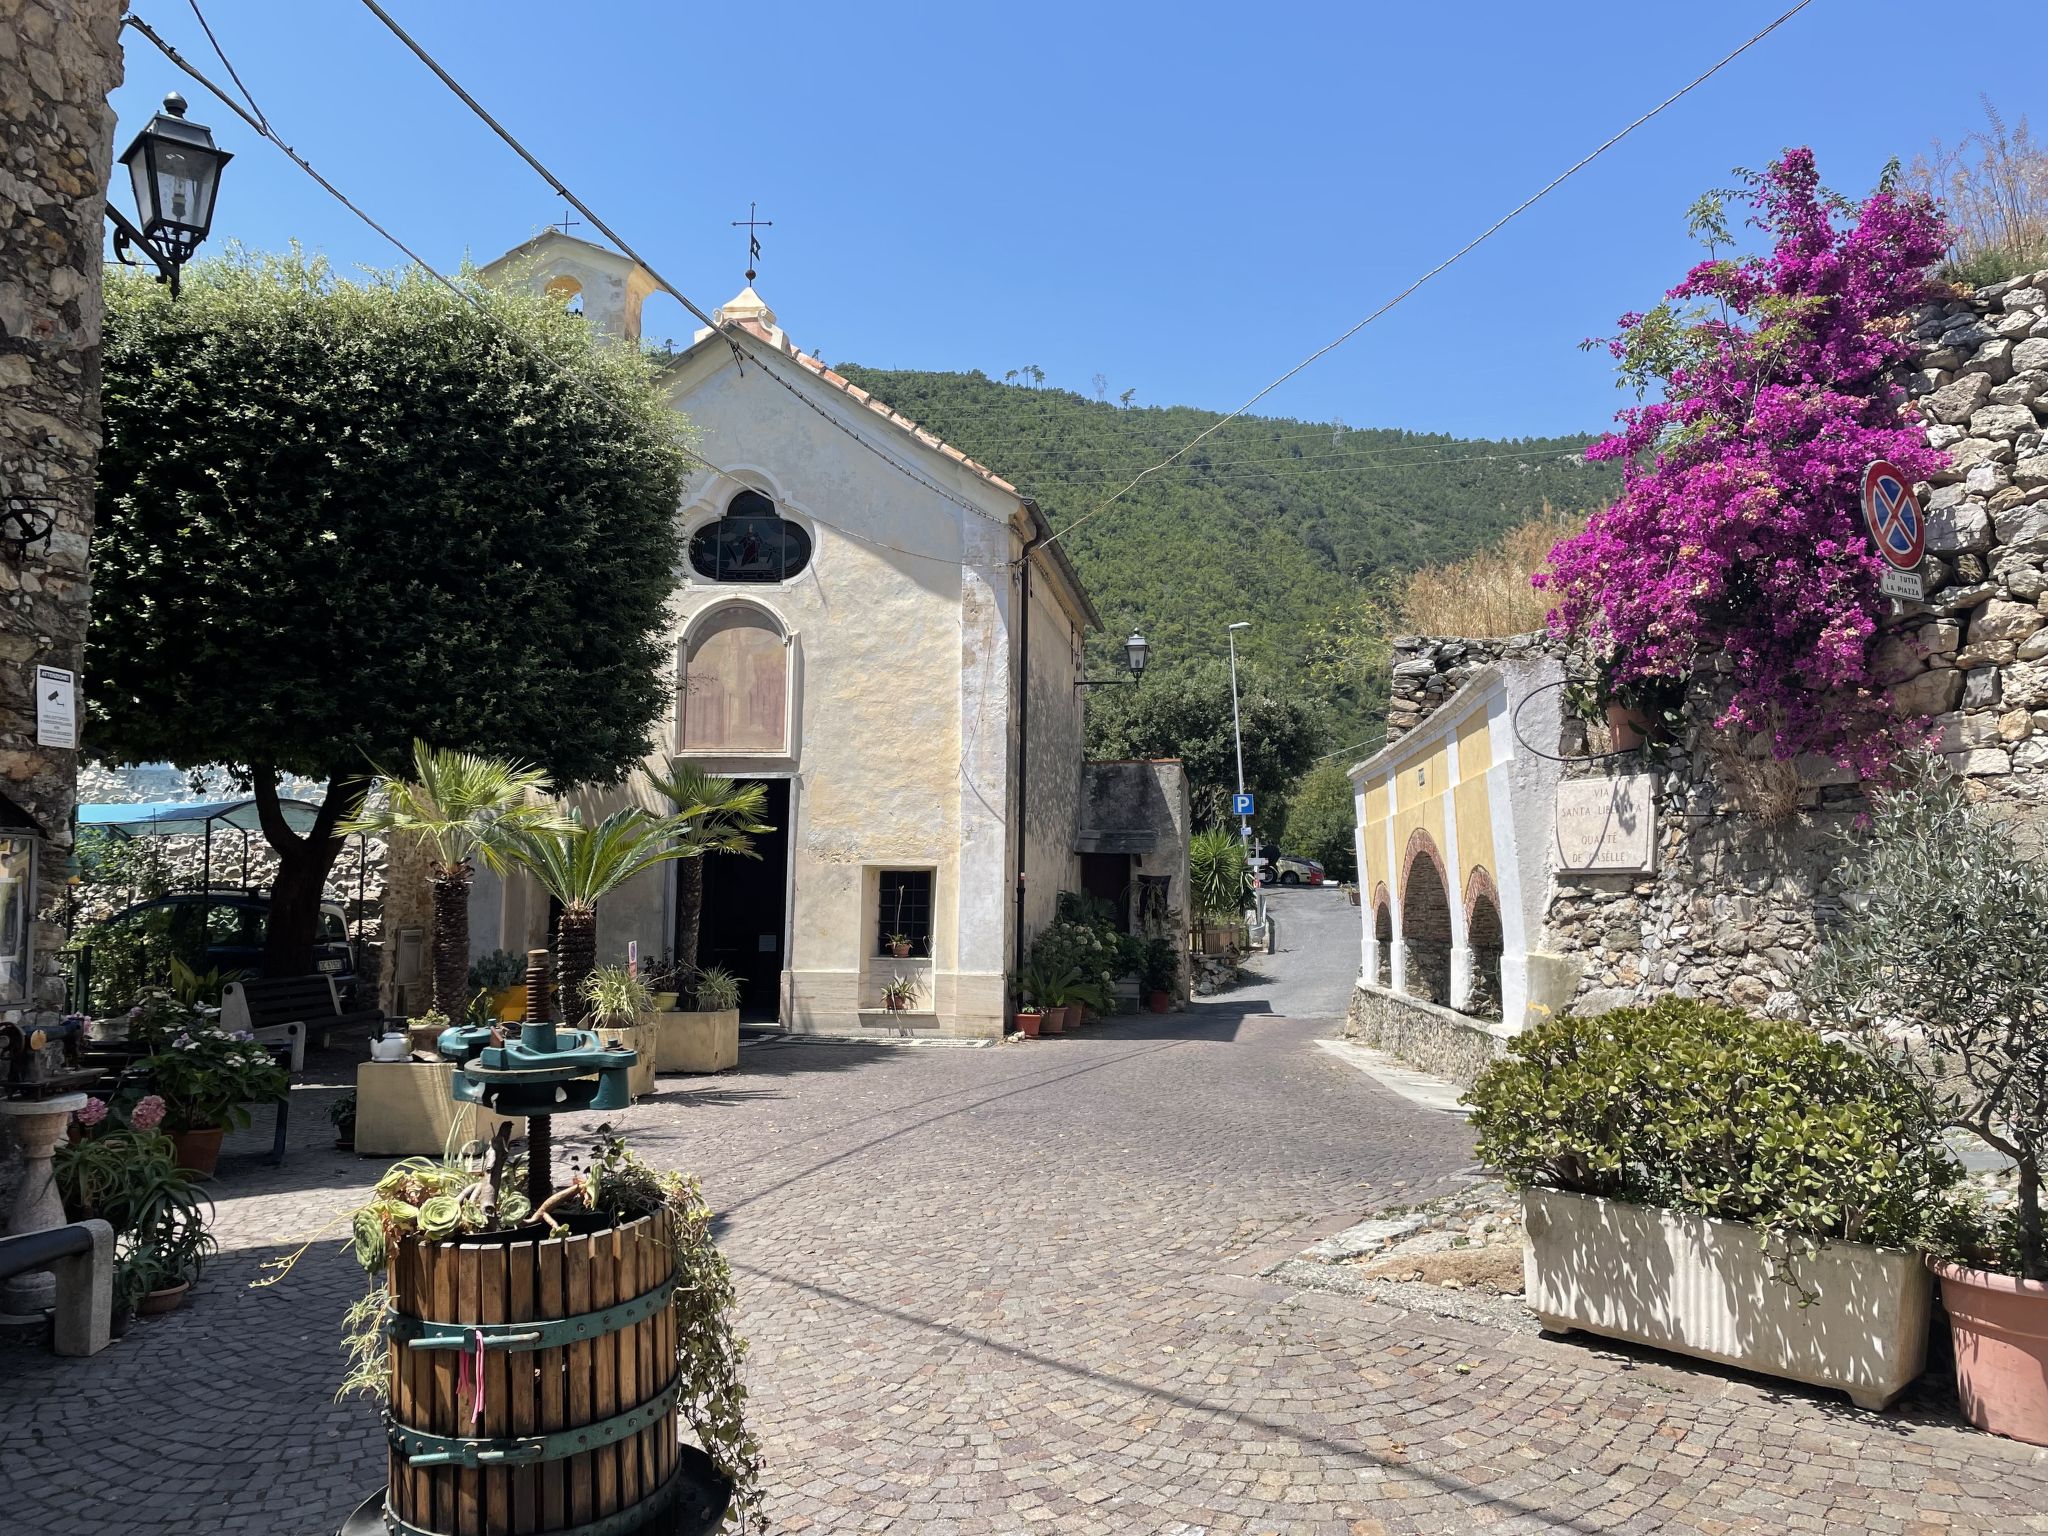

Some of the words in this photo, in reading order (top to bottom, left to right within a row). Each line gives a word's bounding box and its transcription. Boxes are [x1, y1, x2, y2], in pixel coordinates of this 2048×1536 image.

[1887, 573, 1896, 581] SU
[1899, 576, 1918, 585] TUTTA
[1886, 584, 1895, 592] LA
[1897, 586, 1920, 596] PIAZZA
[1593, 788, 1609, 797] VIA
[1238, 797, 1250, 813] P
[1561, 807, 1591, 817] SANTA
[1598, 804, 1642, 815] LIBEA
[1572, 853, 1583, 862] DE
